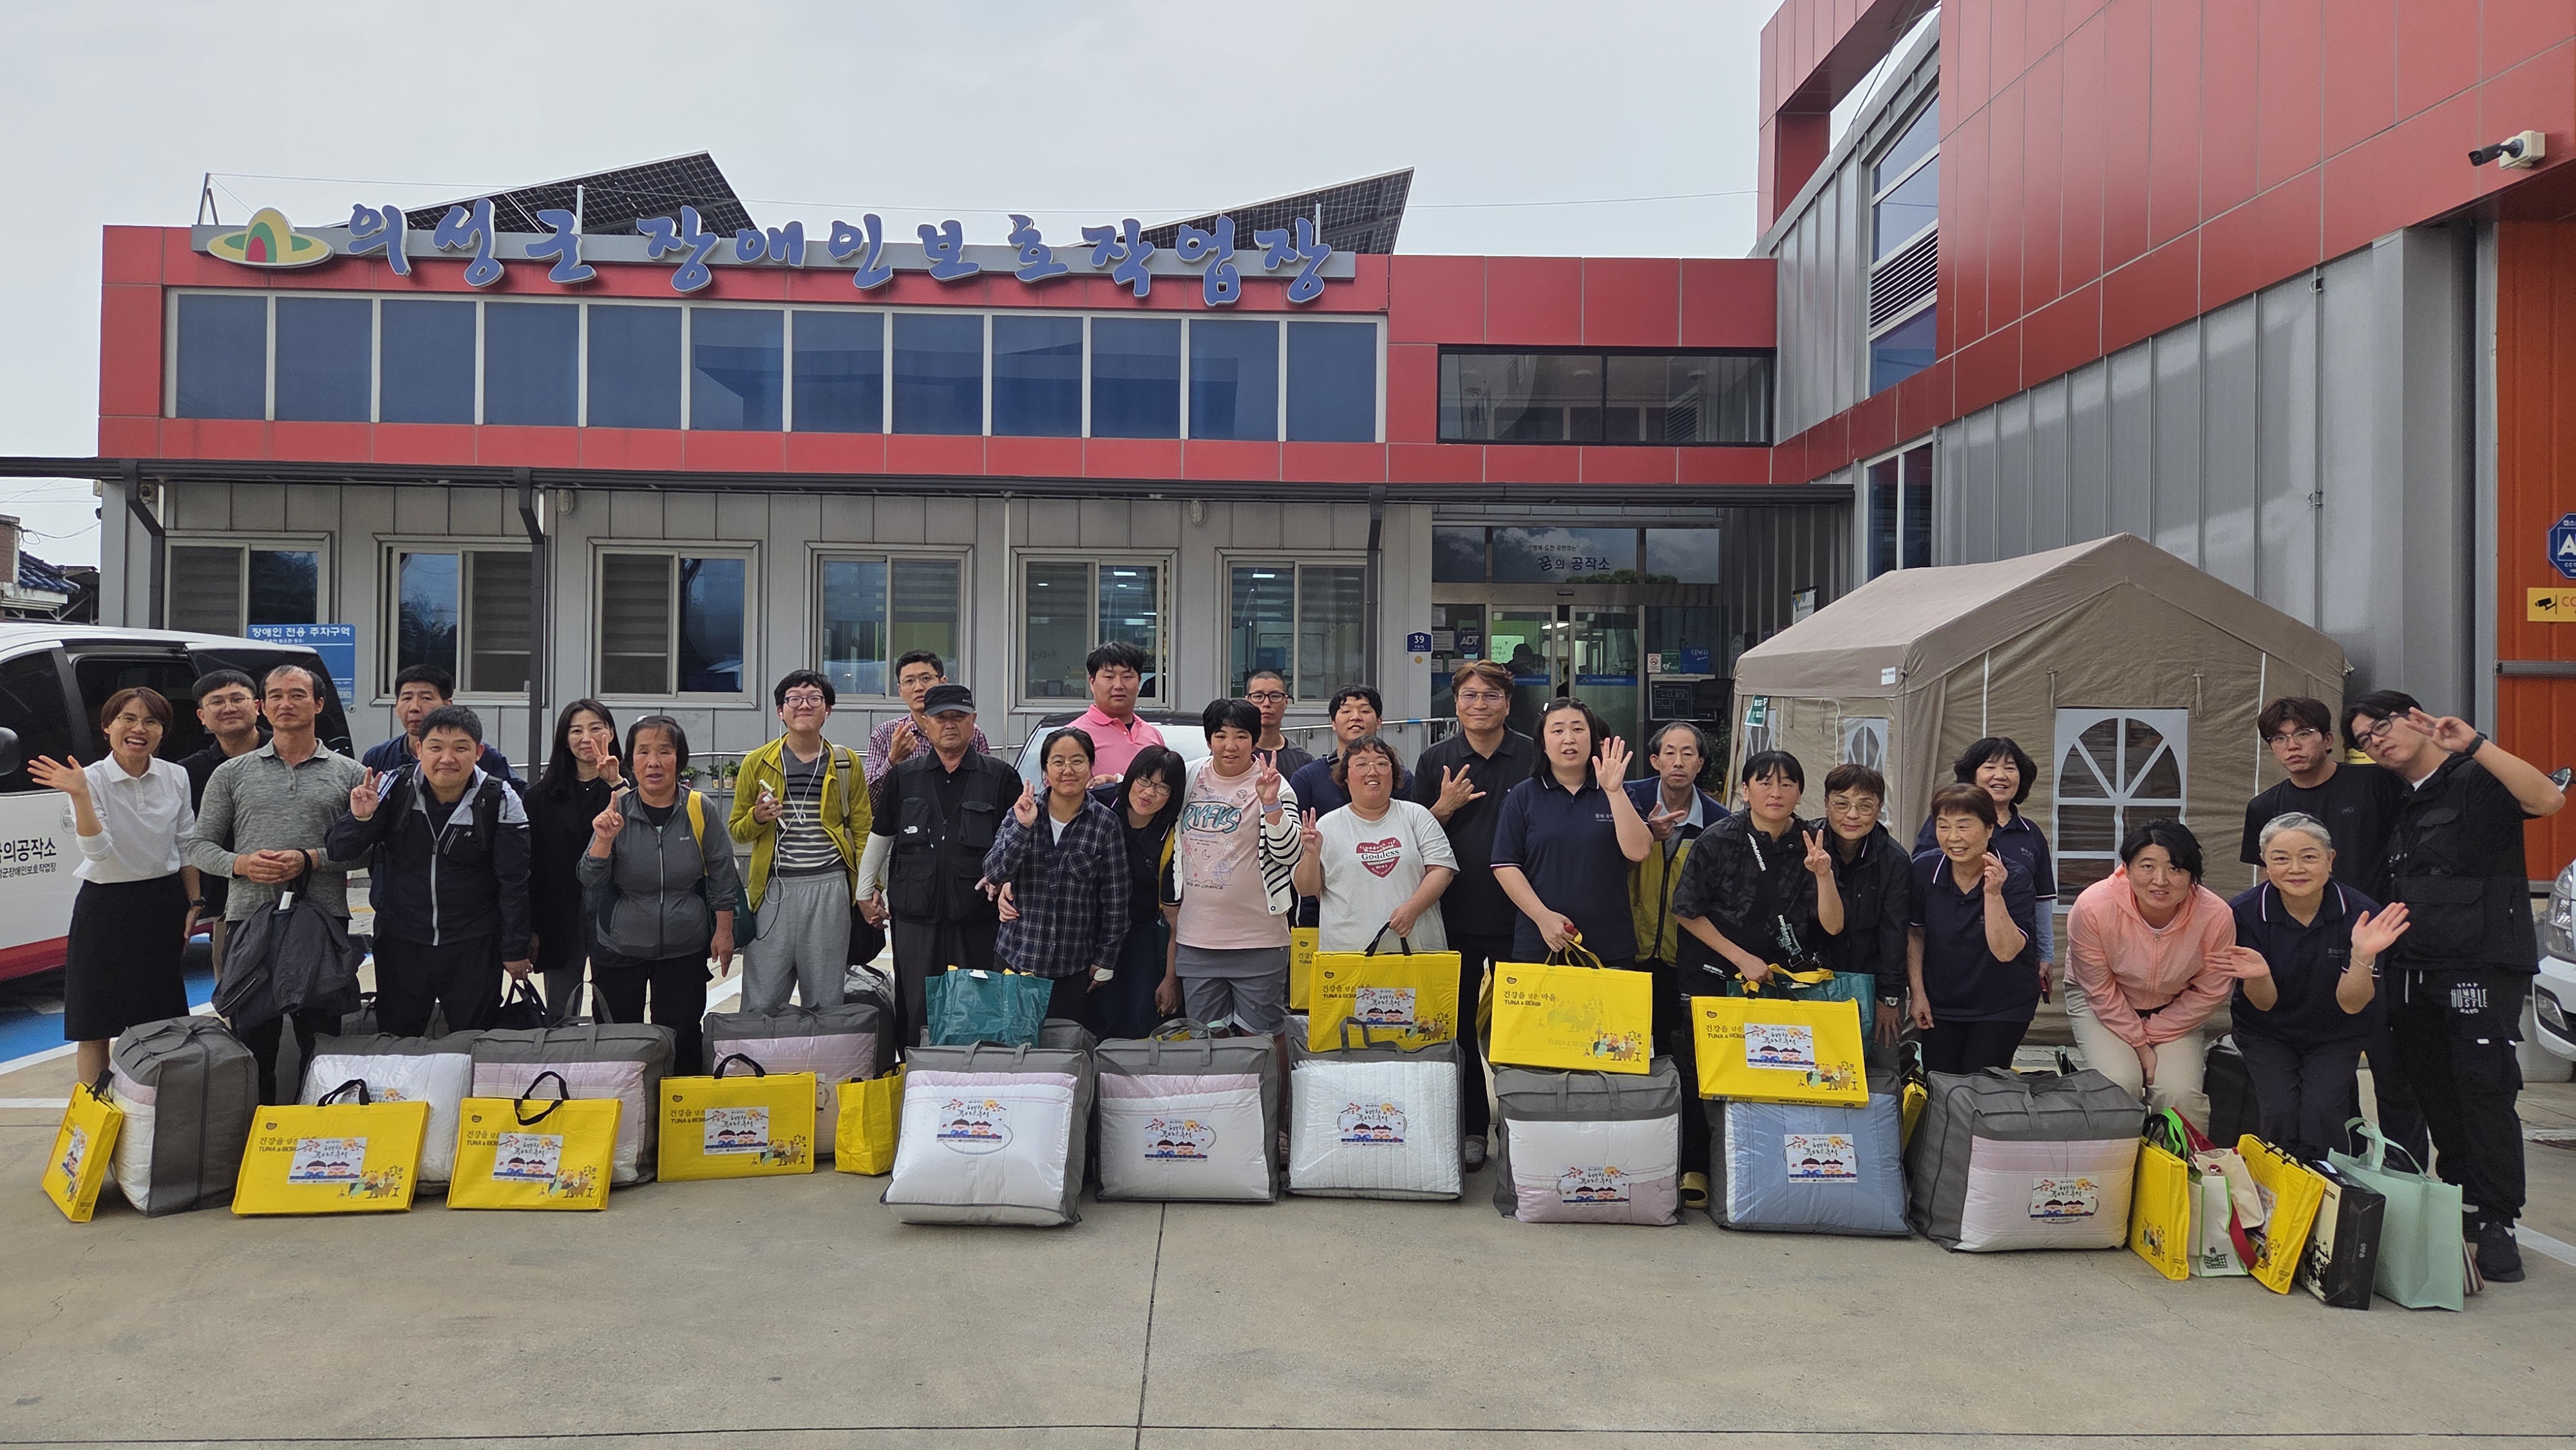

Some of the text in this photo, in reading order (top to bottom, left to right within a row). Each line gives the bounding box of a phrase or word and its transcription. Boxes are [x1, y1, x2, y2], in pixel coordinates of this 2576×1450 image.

[347, 198, 1331, 306] 의성군 장애인보호작업장
[2558, 534, 2576, 556] A
[1537, 555, 1611, 572] 꿈의 공작소
[252, 626, 350, 638] 장애인 전용 주차구역
[1414, 635, 1425, 644] 39
[1459, 635, 1480, 646] ADT
[1181, 805, 1242, 834] RYFKS
[0, 837, 57, 863] 의공작소
[1361, 849, 1400, 860] Goddess
[1322, 984, 1343, 993] 건강을
[1504, 990, 1526, 999] 건강을
[1541, 993, 1557, 1002] 마음
[1706, 1024, 1729, 1033] 건강을
[670, 1109, 692, 1117] 건강을
[466, 1130, 488, 1139] 건강을
[259, 1136, 285, 1145] 건강을
